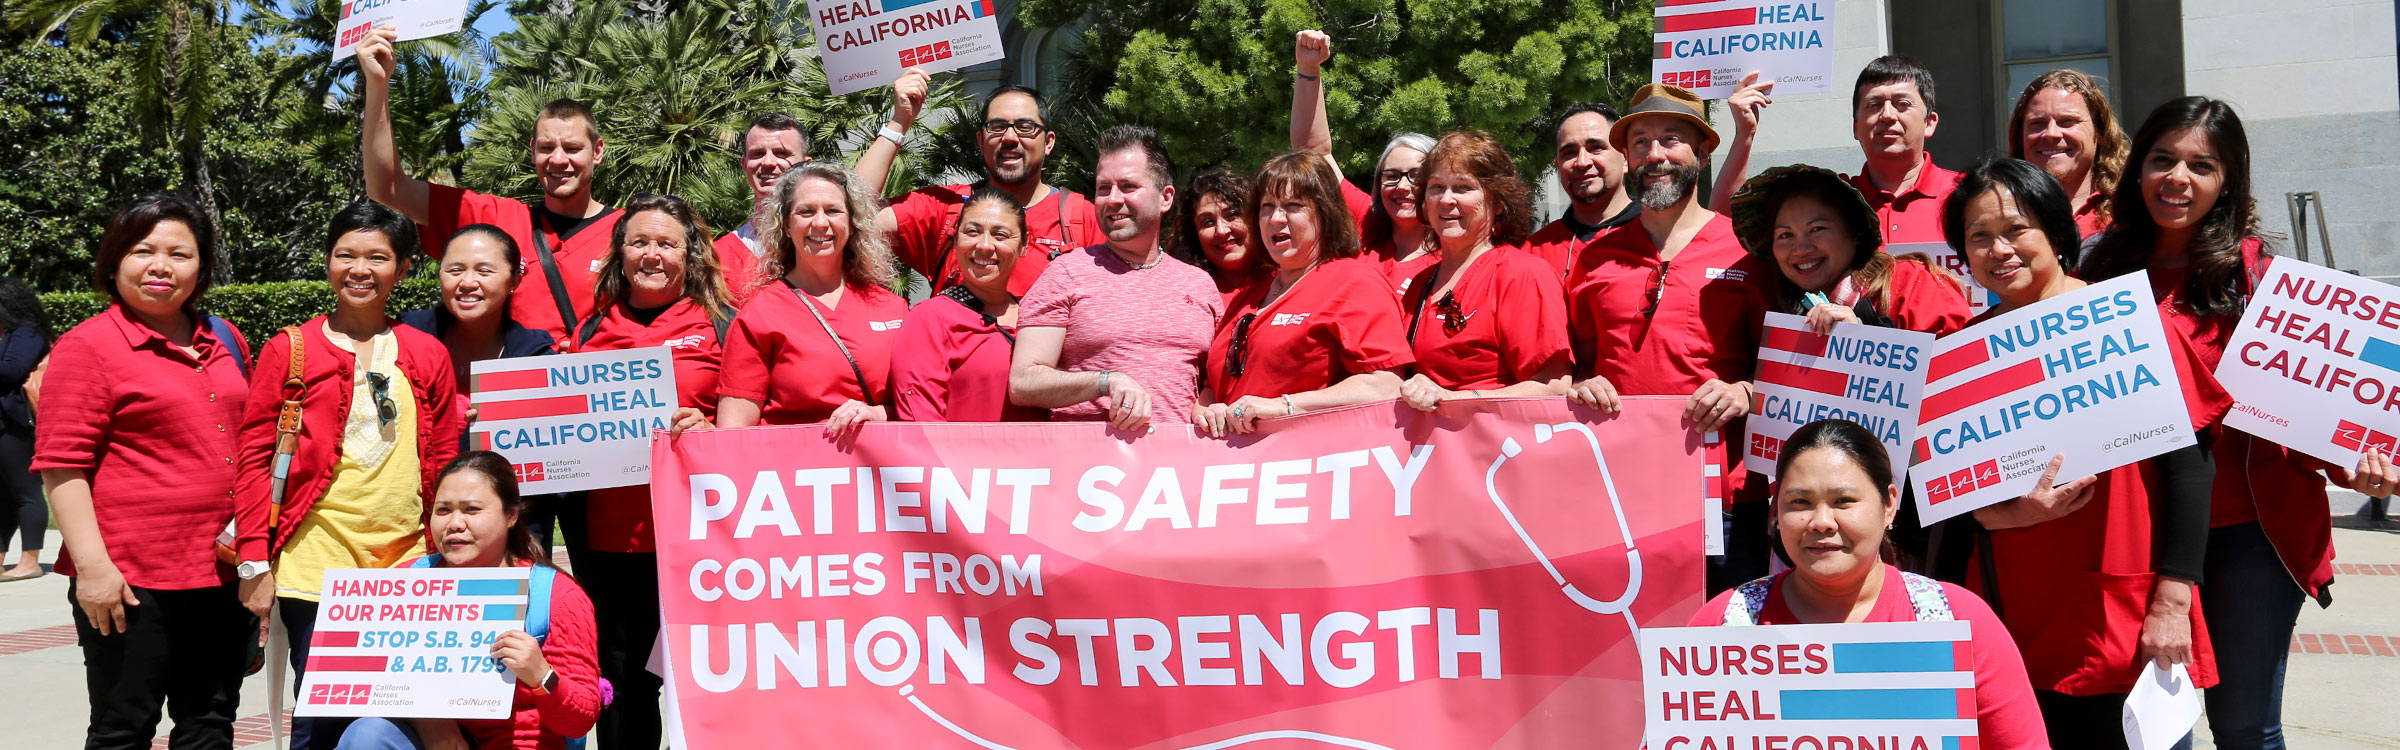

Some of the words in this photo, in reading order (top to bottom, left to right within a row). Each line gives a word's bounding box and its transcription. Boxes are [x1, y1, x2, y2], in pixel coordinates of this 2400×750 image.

[819, 0, 881, 27] HEAL
[1758, 3, 1825, 24] HEAL
[826, 4, 971, 52] CALIFORNIA
[951, 33, 983, 45] California
[952, 41, 975, 51] Nurses
[954, 44, 992, 57] Association
[1674, 29, 1823, 59] CALIFORNIA
[1713, 66, 1742, 75] California
[1776, 74, 1823, 84] @CalNurses
[2272, 272, 2400, 330] NURSE
[1989, 290, 2138, 359] NURSES
[2255, 305, 2355, 358] HEAL
[1827, 335, 1920, 372] NURSES
[2044, 328, 2150, 379] HEAL
[551, 358, 662, 387] NURSES
[2240, 341, 2400, 415] CALIFOR
[590, 388, 666, 413] HEAL
[1847, 374, 1910, 409] HEAL
[1933, 364, 2161, 455] CALIFORNIA
[2231, 400, 2291, 428] CalNurses
[2101, 423, 2176, 453] @CalNurses
[546, 458, 581, 467] California
[2000, 444, 2046, 463] California
[2002, 457, 2036, 473] Nurses
[546, 466, 572, 474] Nurses
[547, 471, 591, 481] Association
[2005, 461, 2050, 481] Associati
[688, 466, 1051, 540] PATIENT
[1071, 444, 1436, 533] SAFETY
[688, 552, 887, 602] COMES
[903, 550, 1043, 598] FROM
[332, 579, 406, 597] HANDS
[412, 579, 454, 597] OFF
[328, 604, 373, 622] OUR
[379, 604, 479, 622] PATIENTS
[362, 631, 420, 648] STOP
[424, 631, 463, 648] S.B.
[470, 631, 497, 648] 94
[689, 615, 986, 694] UNION
[1009, 606, 1502, 688] STRENGTH
[390, 655, 405, 673] &
[410, 656, 453, 673] A.B.
[1659, 643, 1828, 677] NURSES
[373, 691, 398, 699] Nurses
[374, 684, 410, 692] California
[371, 698, 414, 706] Association
[448, 698, 502, 707] @CalNurses
[1662, 690, 1776, 722] HEAL
